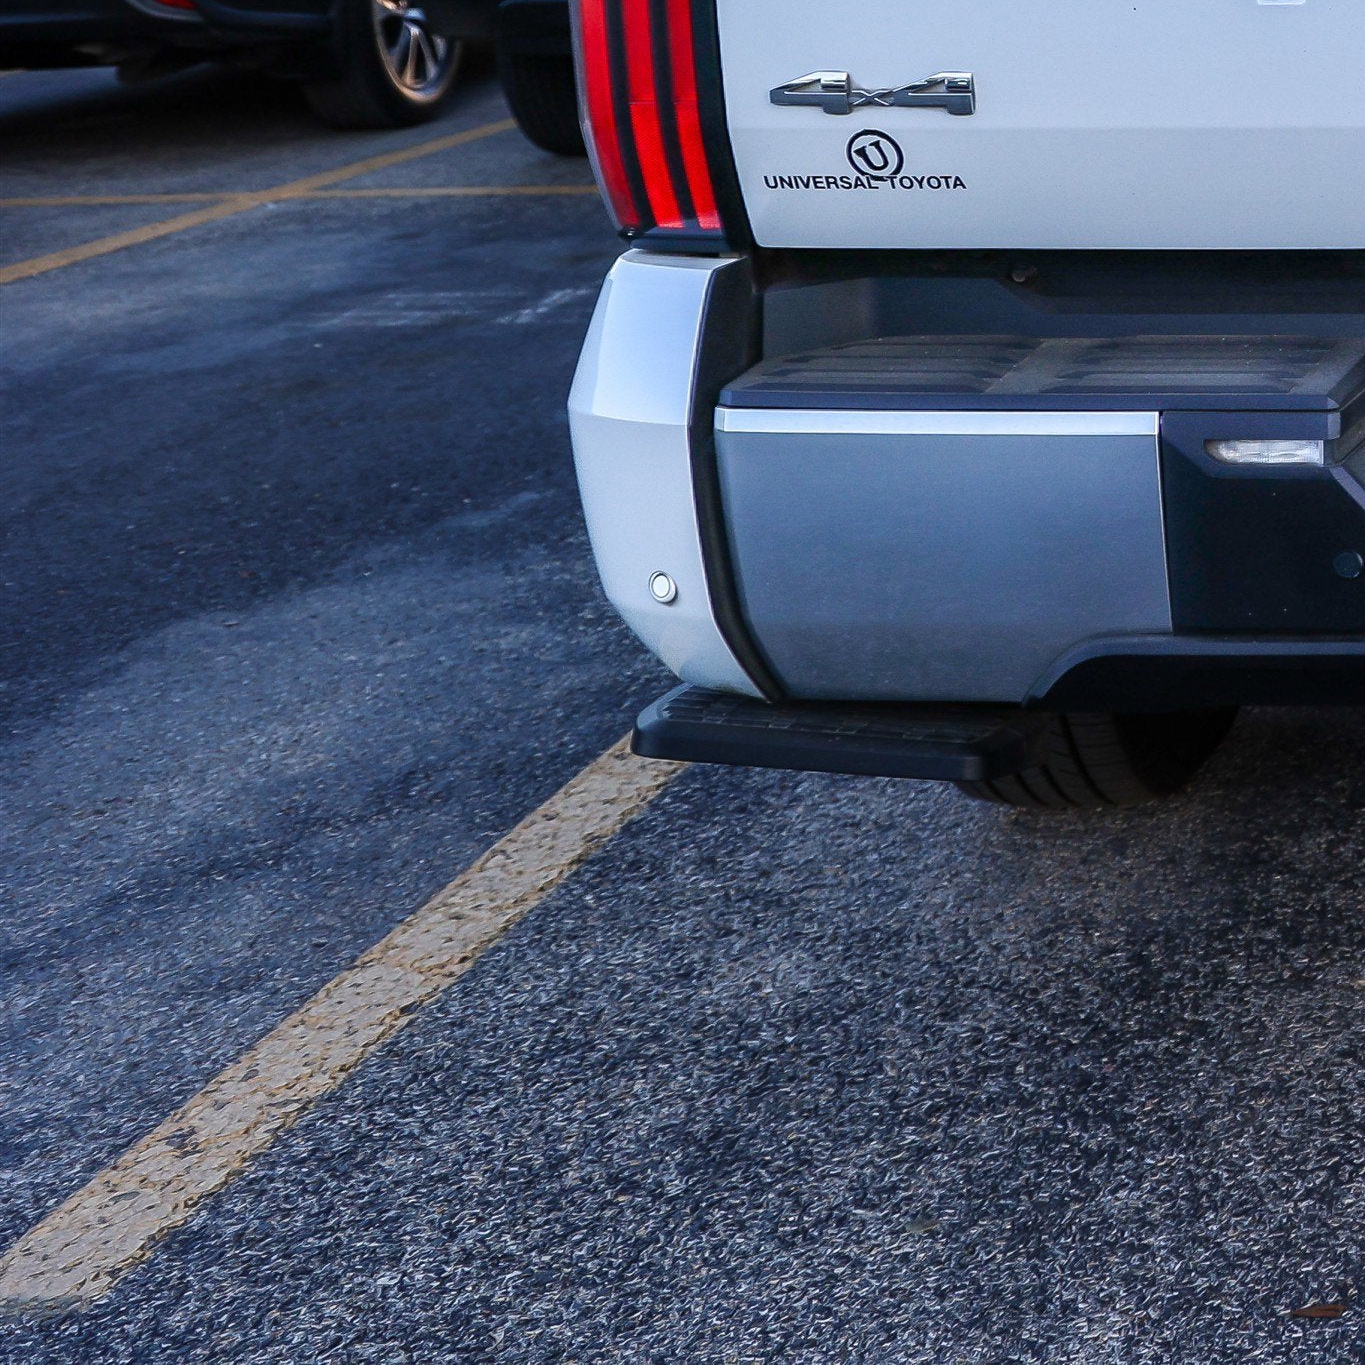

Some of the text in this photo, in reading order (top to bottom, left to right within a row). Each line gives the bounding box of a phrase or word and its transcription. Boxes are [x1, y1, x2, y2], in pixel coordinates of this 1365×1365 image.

[853, 139, 890, 172] U
[763, 175, 967, 190] UNIVERSAL TOYOTA
